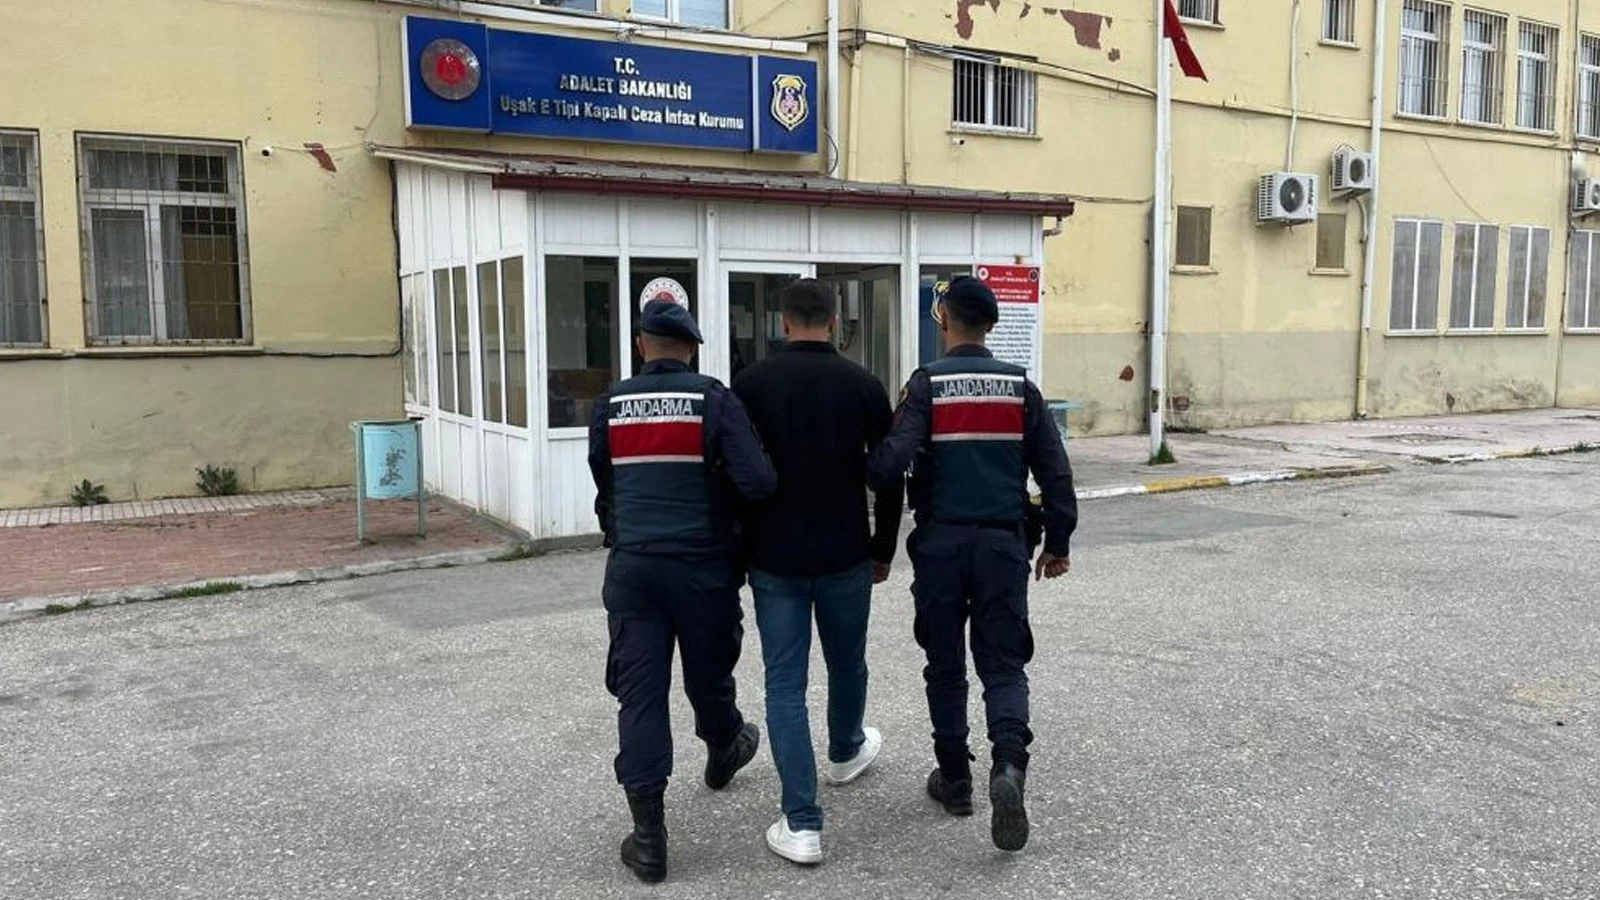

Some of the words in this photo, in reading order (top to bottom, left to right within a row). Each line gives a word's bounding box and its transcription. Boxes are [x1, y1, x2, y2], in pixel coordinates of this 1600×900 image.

[613, 57, 640, 75] T.C.
[560, 74, 614, 93] ADALET
[619, 79, 692, 100] BAKANLIĞI
[499, 94, 536, 116] Uşak
[540, 98, 550, 115] E
[553, 99, 579, 119] Tipi
[584, 101, 627, 122] Kapalı
[630, 105, 663, 124] Ceza
[665, 105, 696, 126] İnfaz
[699, 111, 744, 130] Kurumu
[939, 378, 1015, 398] JANDARMA
[616, 398, 693, 418] JANDARMA
